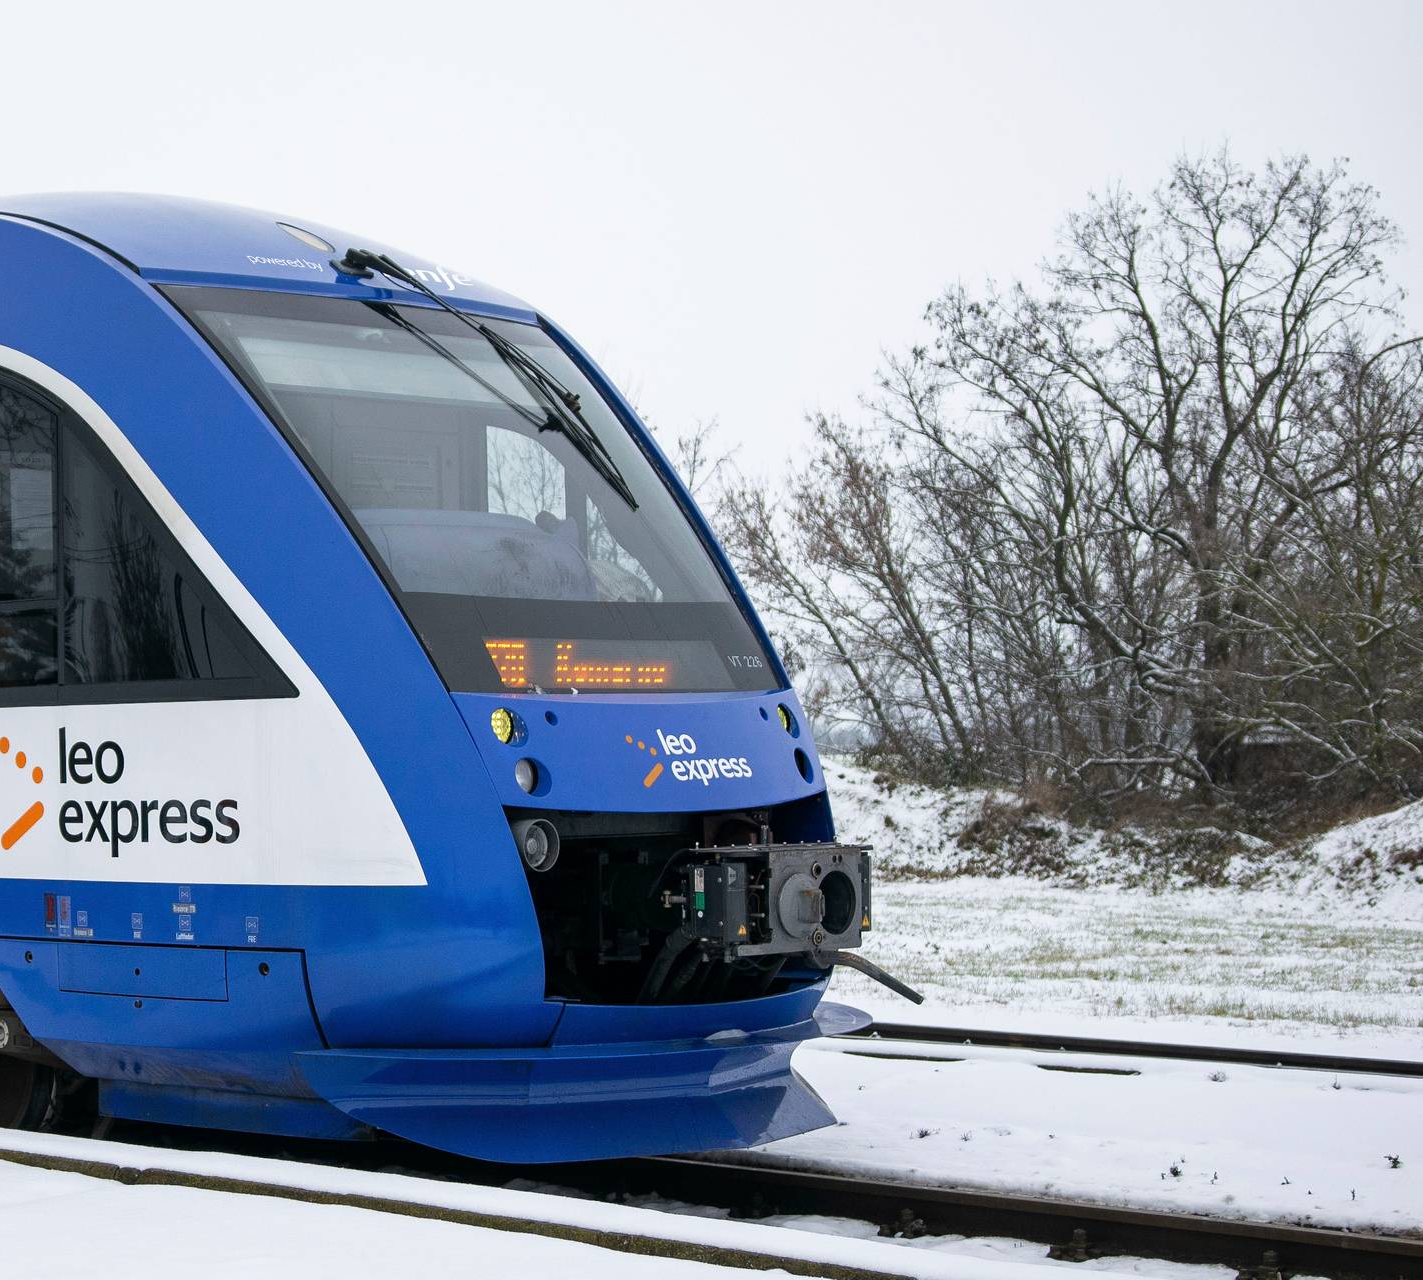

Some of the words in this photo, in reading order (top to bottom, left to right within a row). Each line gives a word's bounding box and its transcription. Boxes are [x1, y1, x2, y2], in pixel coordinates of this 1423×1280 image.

[246, 254, 307, 268] powered
[305, 259, 323, 272] by
[727, 655, 742, 667] VT
[59, 727, 125, 785] leo
[656, 728, 696, 756] leo
[671, 757, 753, 786] express
[59, 799, 241, 858] express
